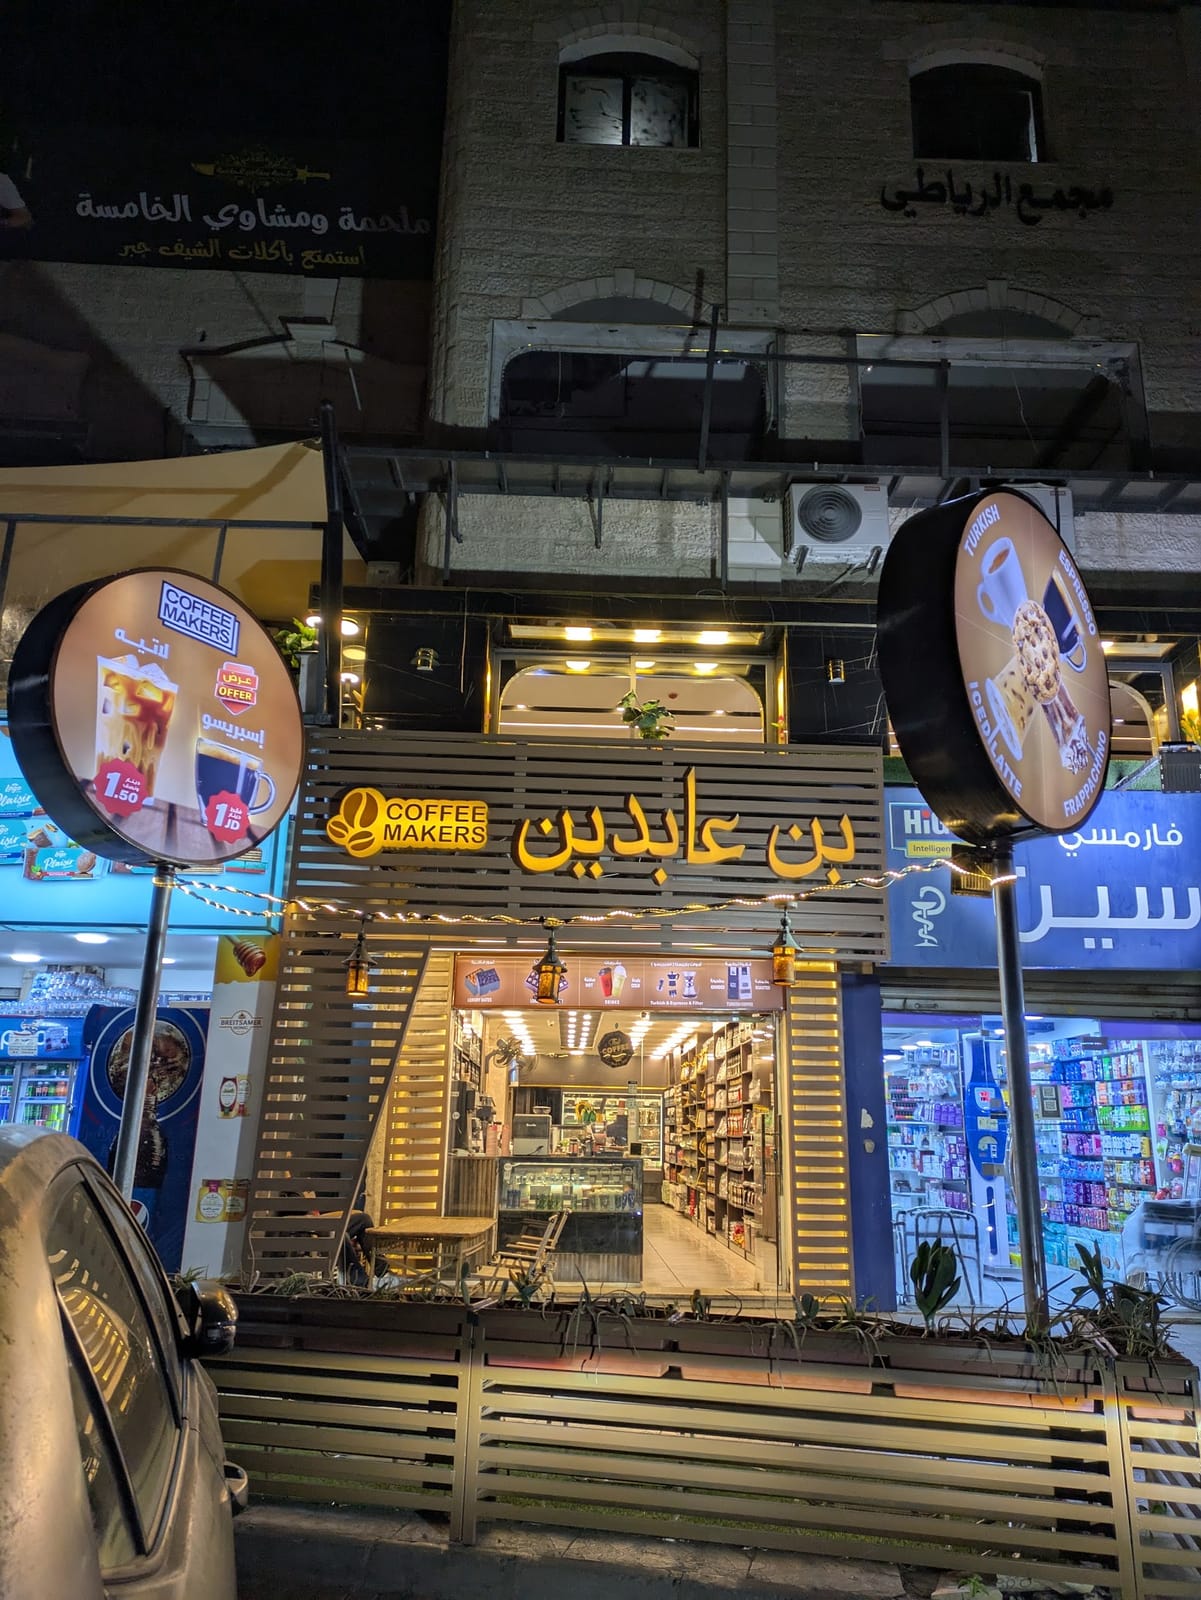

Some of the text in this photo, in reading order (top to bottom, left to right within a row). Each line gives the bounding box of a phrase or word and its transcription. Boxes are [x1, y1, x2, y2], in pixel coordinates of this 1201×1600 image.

[75, 191, 431, 234] ملحمة ومشاوي الخامسة
[1016, 183, 1114, 225] مجمع
[118, 240, 150, 257] جبر
[159, 238, 222, 259] الشيف
[301, 245, 365, 269] استمتع
[964, 503, 1000, 557] TURKISH
[166, 589, 232, 630] COFFEE
[1059, 549, 1096, 636] ESPRESSO
[163, 603, 231, 644] MAKERS
[218, 686, 252, 701] OFFER
[222, 672, 252, 685] عرض
[202, 713, 265, 749] إسبريسو
[969, 681, 1022, 799] ICED LATTE
[1063, 730, 1107, 817] FRAPPACHINO
[224, 818, 241, 831] JD
[386, 803, 486, 823] COFFEE
[515, 766, 855, 886] بن عابدين
[903, 809, 949, 835] HiG
[383, 824, 485, 843] MAKERS
[913, 844, 951, 854] Intelligen
[1058, 822, 1184, 857] فارمسي
